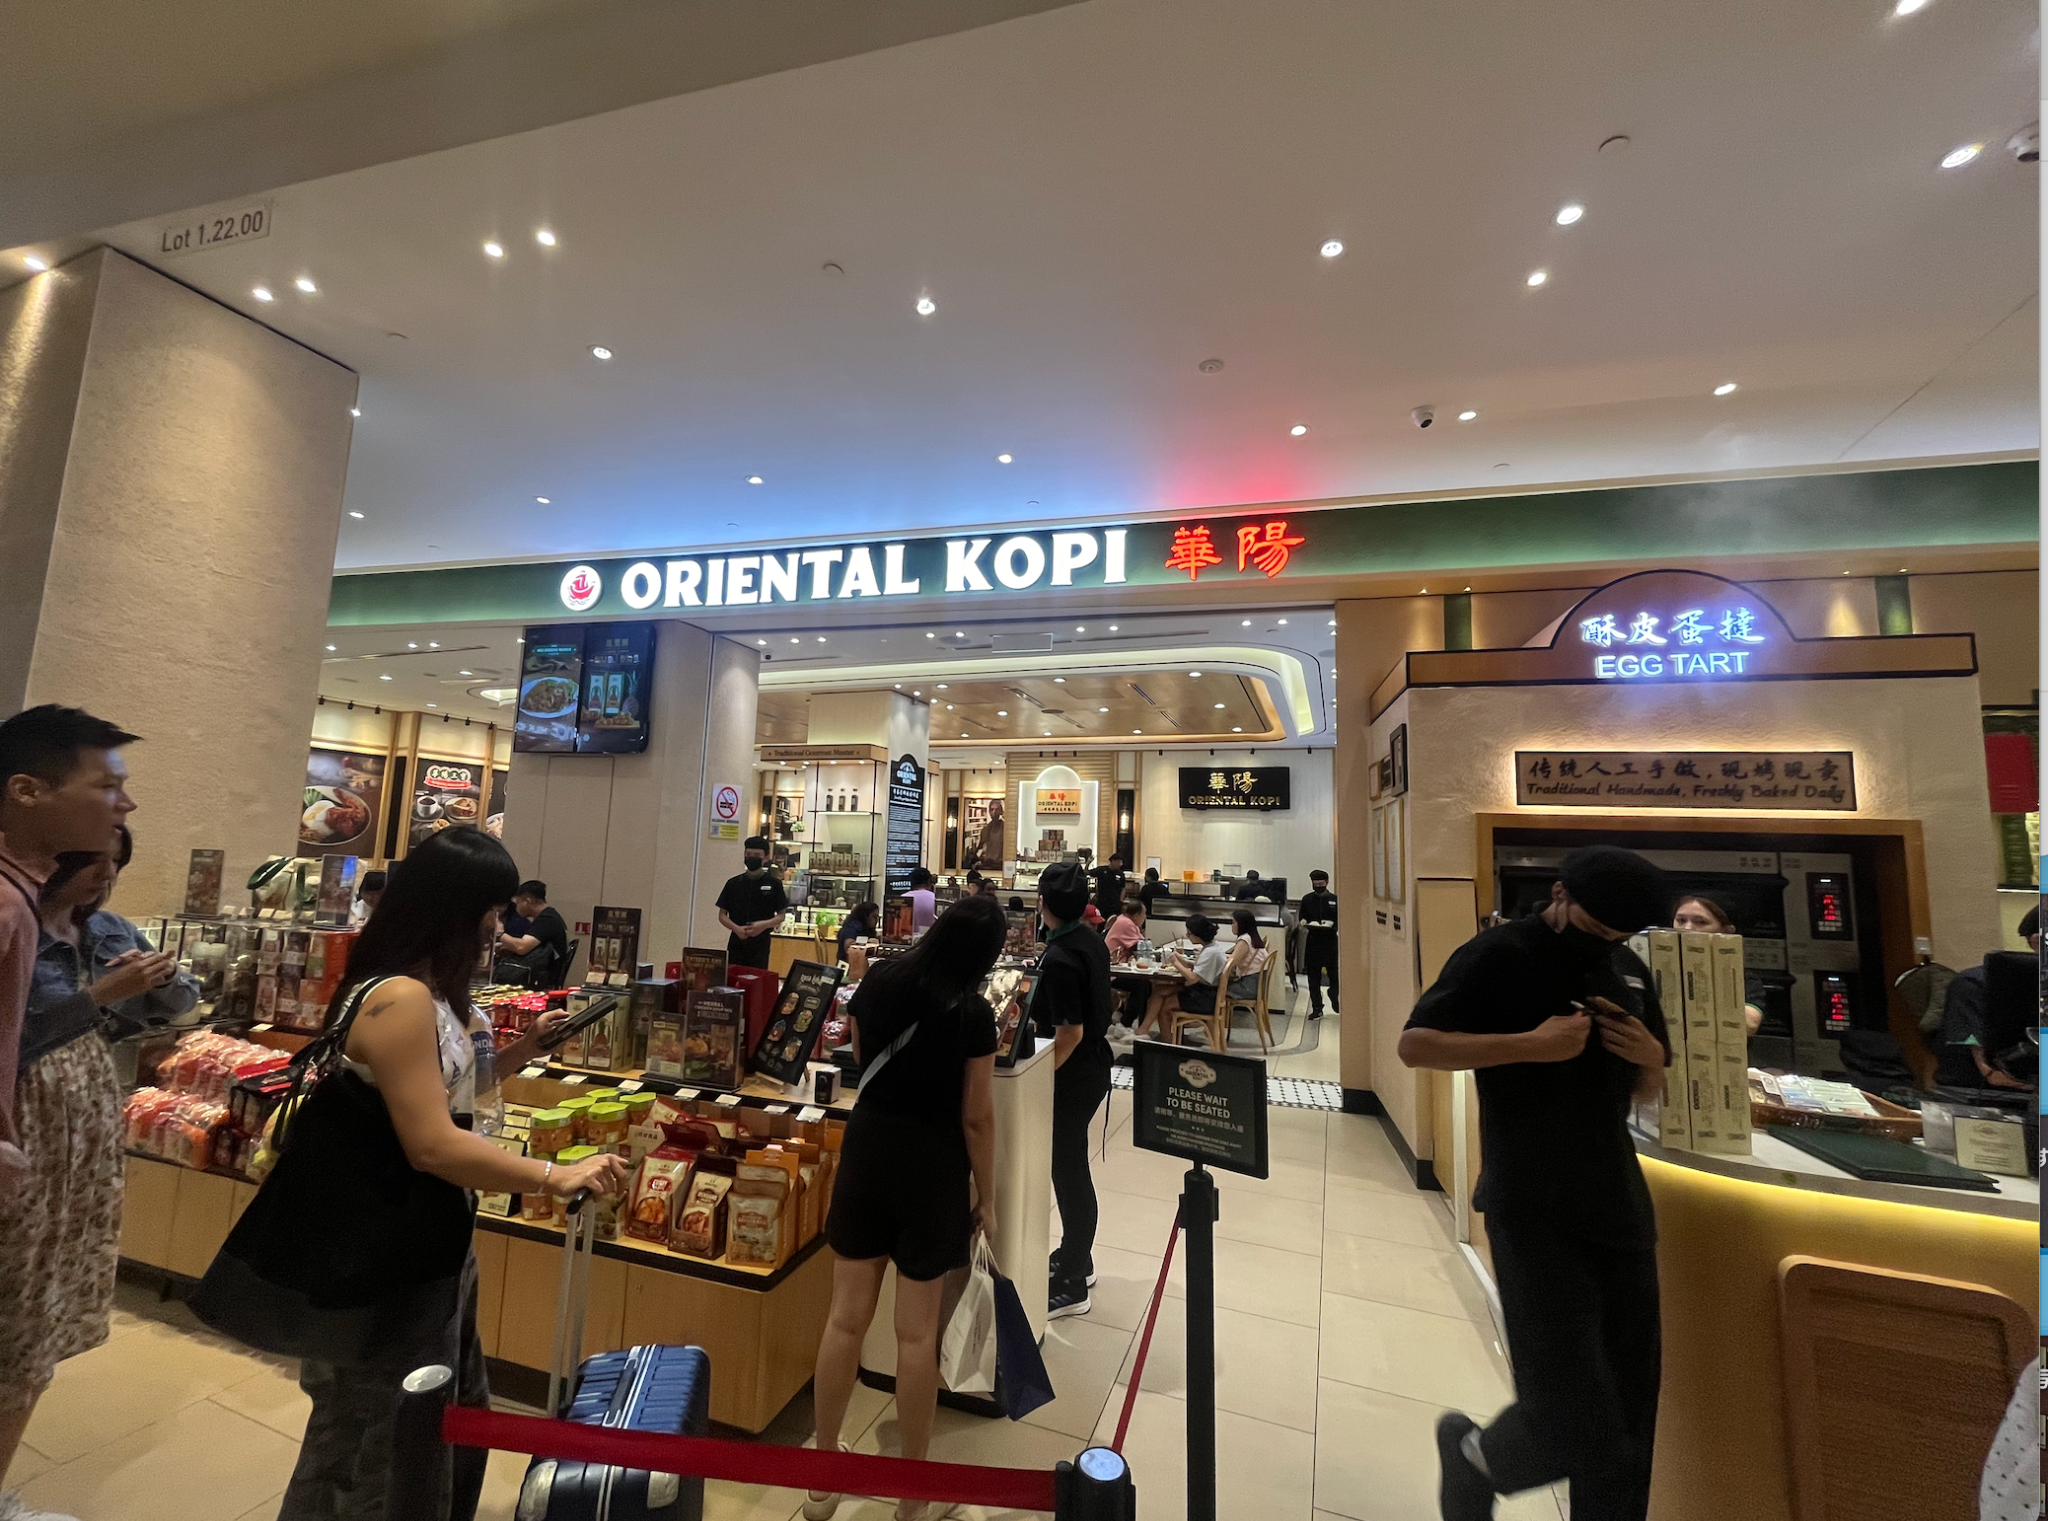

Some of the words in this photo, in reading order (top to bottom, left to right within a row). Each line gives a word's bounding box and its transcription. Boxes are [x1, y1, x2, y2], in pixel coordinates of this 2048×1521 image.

[162, 229, 190, 252] Lot
[198, 211, 263, 245] 1.22.00
[1164, 521, 1306, 581] 華陽
[620, 544, 920, 610] ORIENTAL
[944, 529, 1128, 592] KOPI
[1580, 607, 1766, 647] 酥皮蛋撻
[1595, 654, 1663, 678] EGG
[1669, 651, 1750, 675] TART
[774, 749, 805, 757] Traditional
[1207, 771, 1259, 794] 華陽
[1526, 782, 1601, 795] Traditional
[1607, 783, 1686, 798] Handmade,
[1693, 784, 1745, 802] Freshly
[1750, 785, 1799, 798] Baked
[1805, 785, 1845, 803] Daily
[1188, 795, 1246, 805] ORIENTAL
[1250, 796, 1280, 805] KOPI
[1166, 1097, 1179, 1108] TO
[1181, 1099, 1193, 1110] BE
[1194, 1103, 1230, 1119] SEATED
[1168, 1087, 1202, 1102] PLEASE
[1203, 1093, 1228, 1107] WAIT
